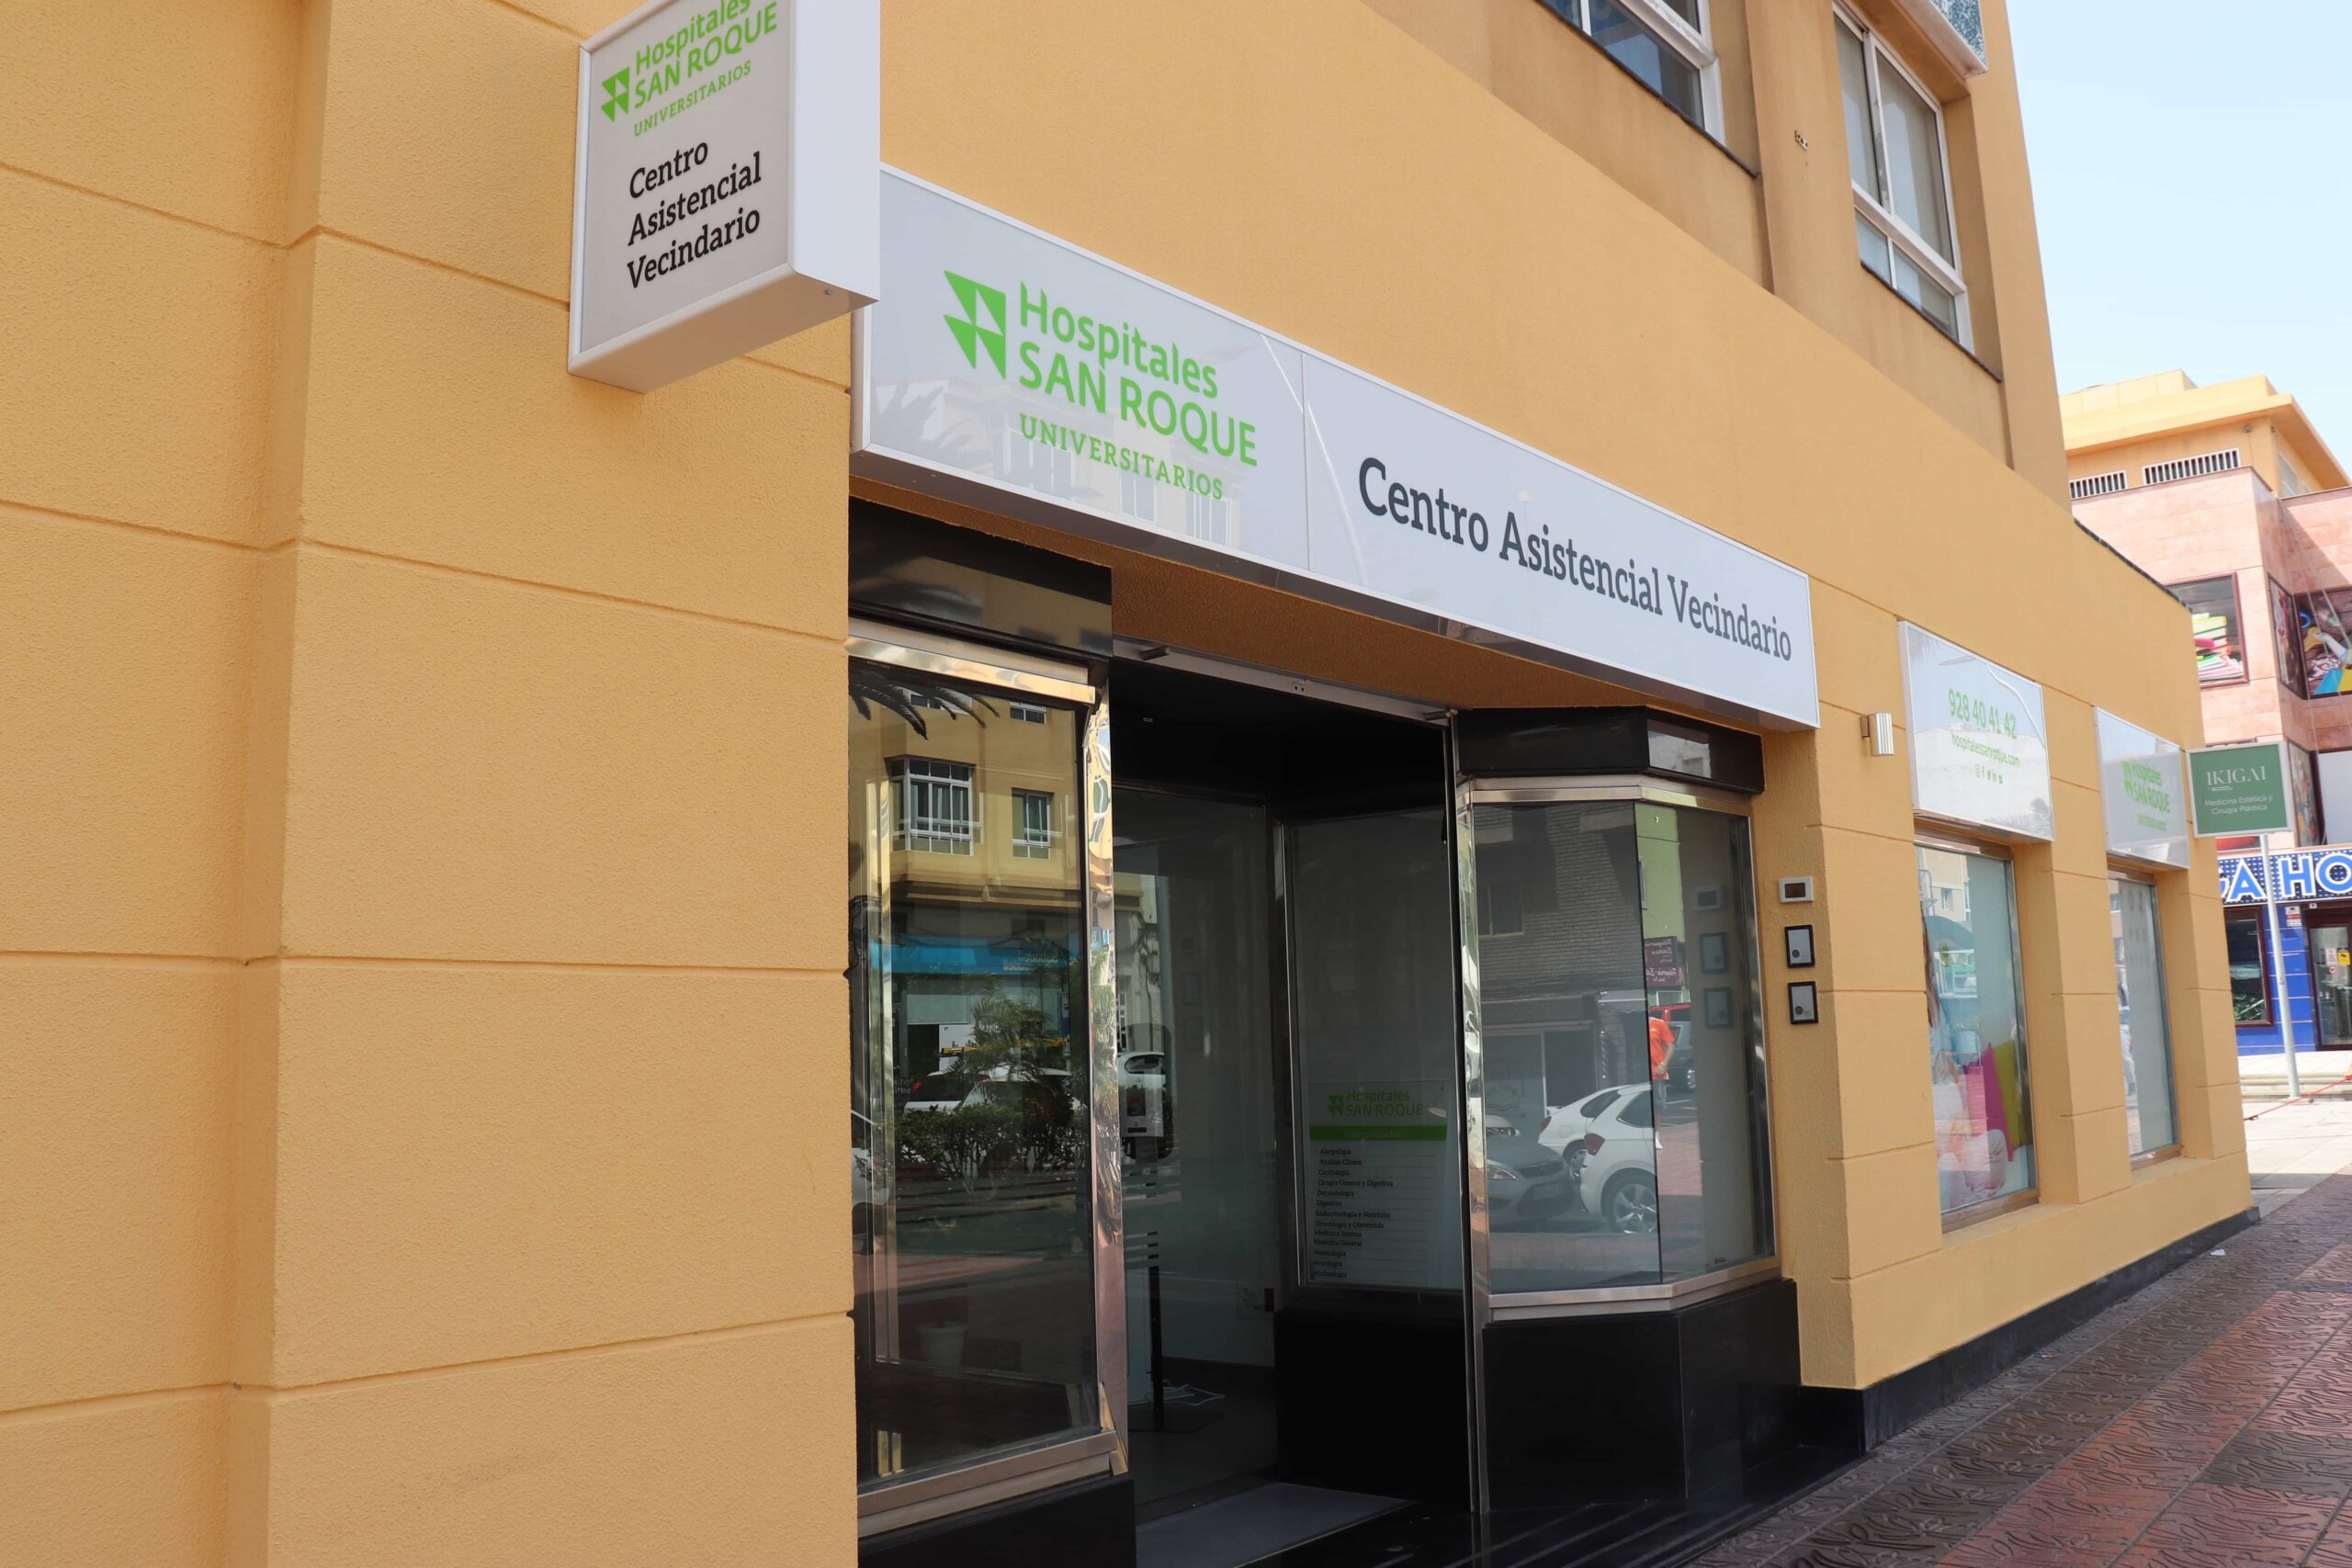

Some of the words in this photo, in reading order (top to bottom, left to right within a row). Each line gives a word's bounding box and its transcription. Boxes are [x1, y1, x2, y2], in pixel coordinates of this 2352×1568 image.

[634, 59, 681, 108] SAN
[687, 2, 777, 78] ROQUE
[636, 0, 752, 75] Hospitales
[634, 61, 752, 137] UNIVERSITARIOS
[628, 151, 762, 246] Asistencial
[629, 141, 708, 199] Centro
[628, 209, 761, 288] Vecindario
[1021, 281, 1218, 399] Hospitales
[1020, 342, 1106, 413] SAN
[1120, 377, 1258, 467] ROQUE
[1019, 413, 1224, 501] UNIVERSITARIOS
[1359, 457, 1489, 552] Centro
[1498, 511, 1663, 615] Asistencial
[1668, 574, 1792, 661] Vecindario
[1949, 688, 1970, 722] 928
[1973, 699, 1986, 728] 40
[1989, 705, 2001, 735] 41
[2005, 712, 2018, 739] 42
[2205, 798, 2237, 807] Medicina
[2206, 765, 2267, 785] IKIGAI
[2220, 858, 2267, 902] A
[1346, 1103, 1373, 1117] SAN
[1375, 1103, 1423, 1117] ROQUE
[1347, 1089, 1410, 1104] Hospitales
